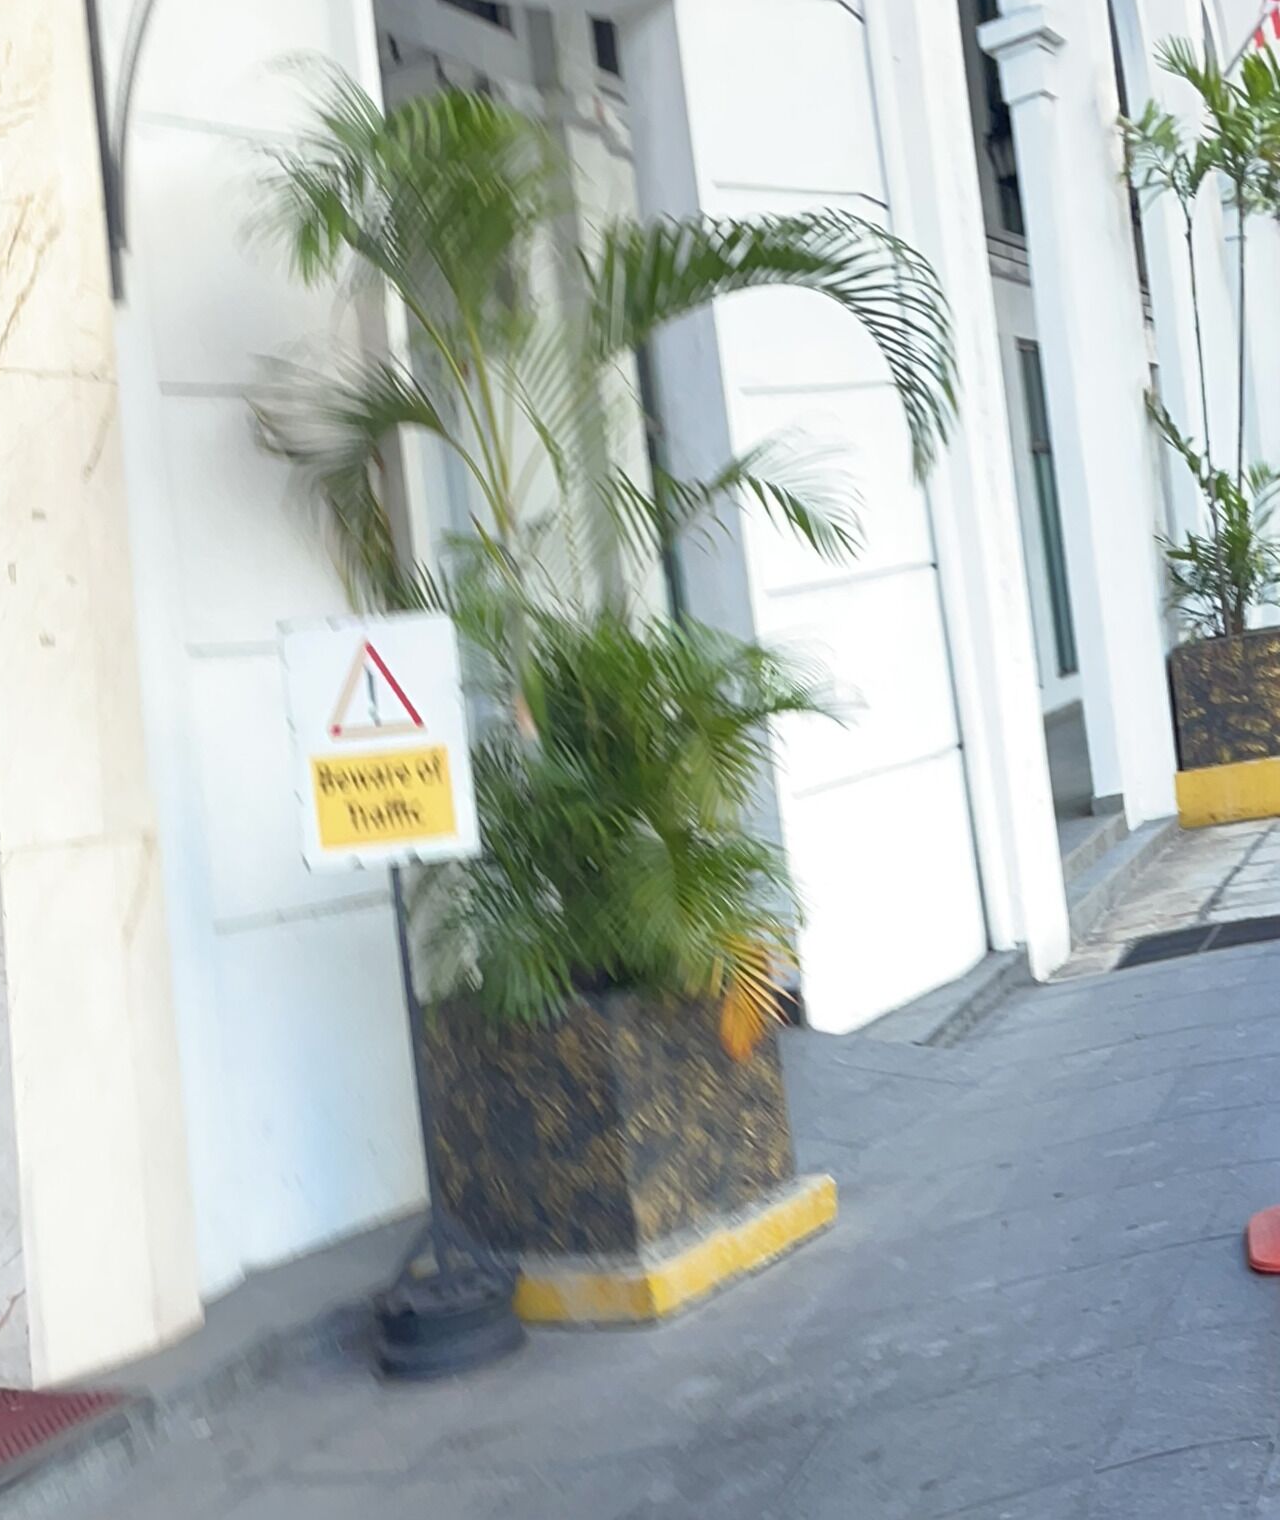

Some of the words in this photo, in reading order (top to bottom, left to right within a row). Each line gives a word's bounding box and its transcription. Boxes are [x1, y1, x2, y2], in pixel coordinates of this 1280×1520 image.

[317, 760, 412, 795] Beware
[414, 748, 443, 783] of
[345, 796, 424, 832] Traffic
